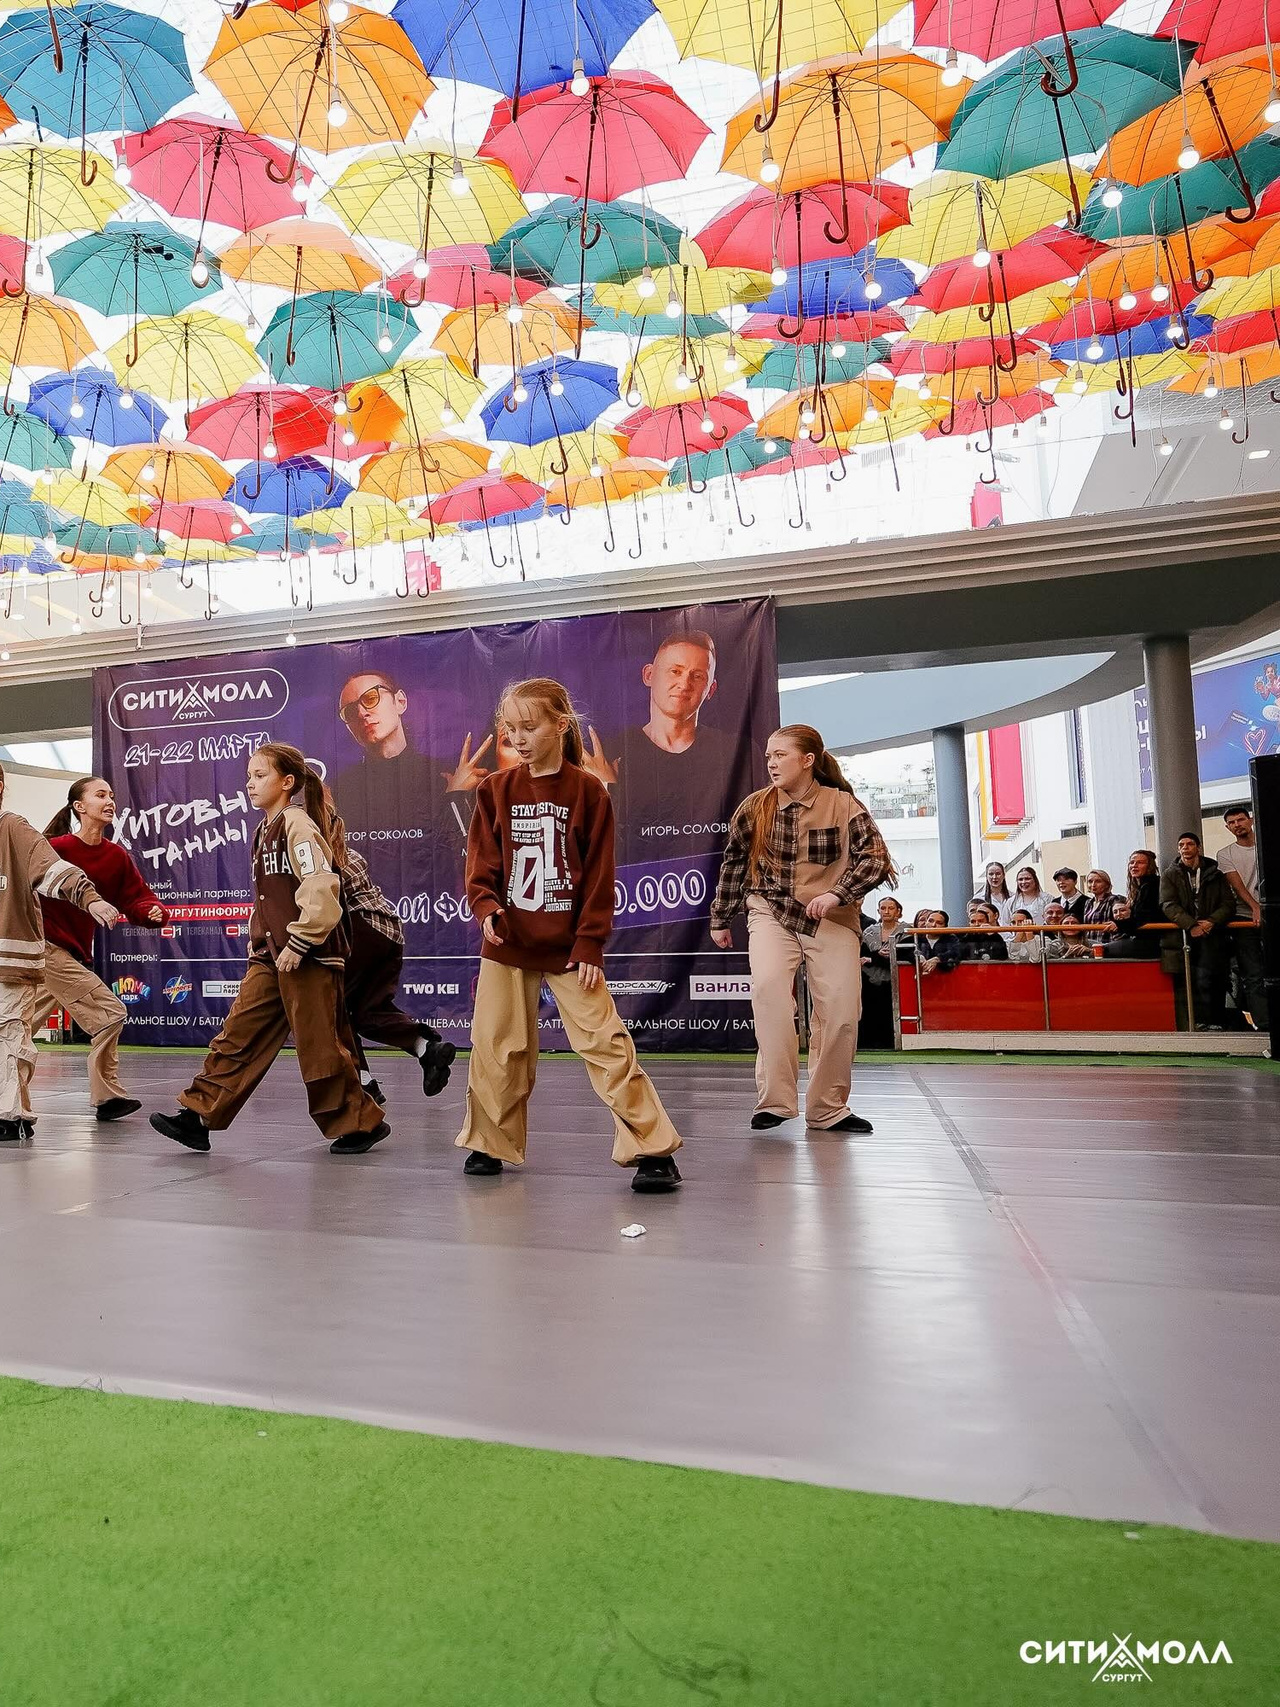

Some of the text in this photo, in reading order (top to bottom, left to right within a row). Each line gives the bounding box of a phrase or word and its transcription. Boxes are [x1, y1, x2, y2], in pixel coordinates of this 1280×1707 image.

[178, 710, 208, 720] СУРГУТ
[123, 741, 194, 767] 21-22
[511, 804, 536, 817] STAY
[112, 790, 261, 850] ХИТОВЫ
[370, 829, 424, 841] СОКОЛОВ
[641, 825, 679, 836] ИГОРЬ
[143, 819, 248, 869] ТАНЦЫ
[146, 880, 173, 889] ьный
[204, 888, 251, 900] партнер:
[166, 905, 255, 918] УРГУТИНФОРМТ
[387, 891, 475, 924] ОЙ ФО
[110, 952, 158, 964] Партнеры:
[402, 983, 460, 995] TWO KEI
[694, 982, 753, 993] ванла
[166, 1015, 190, 1026] ШОУ
[199, 1016, 225, 1026] БАТТЛ
[688, 1018, 720, 1030] ШОУ
[732, 1018, 755, 1030] БАТ
